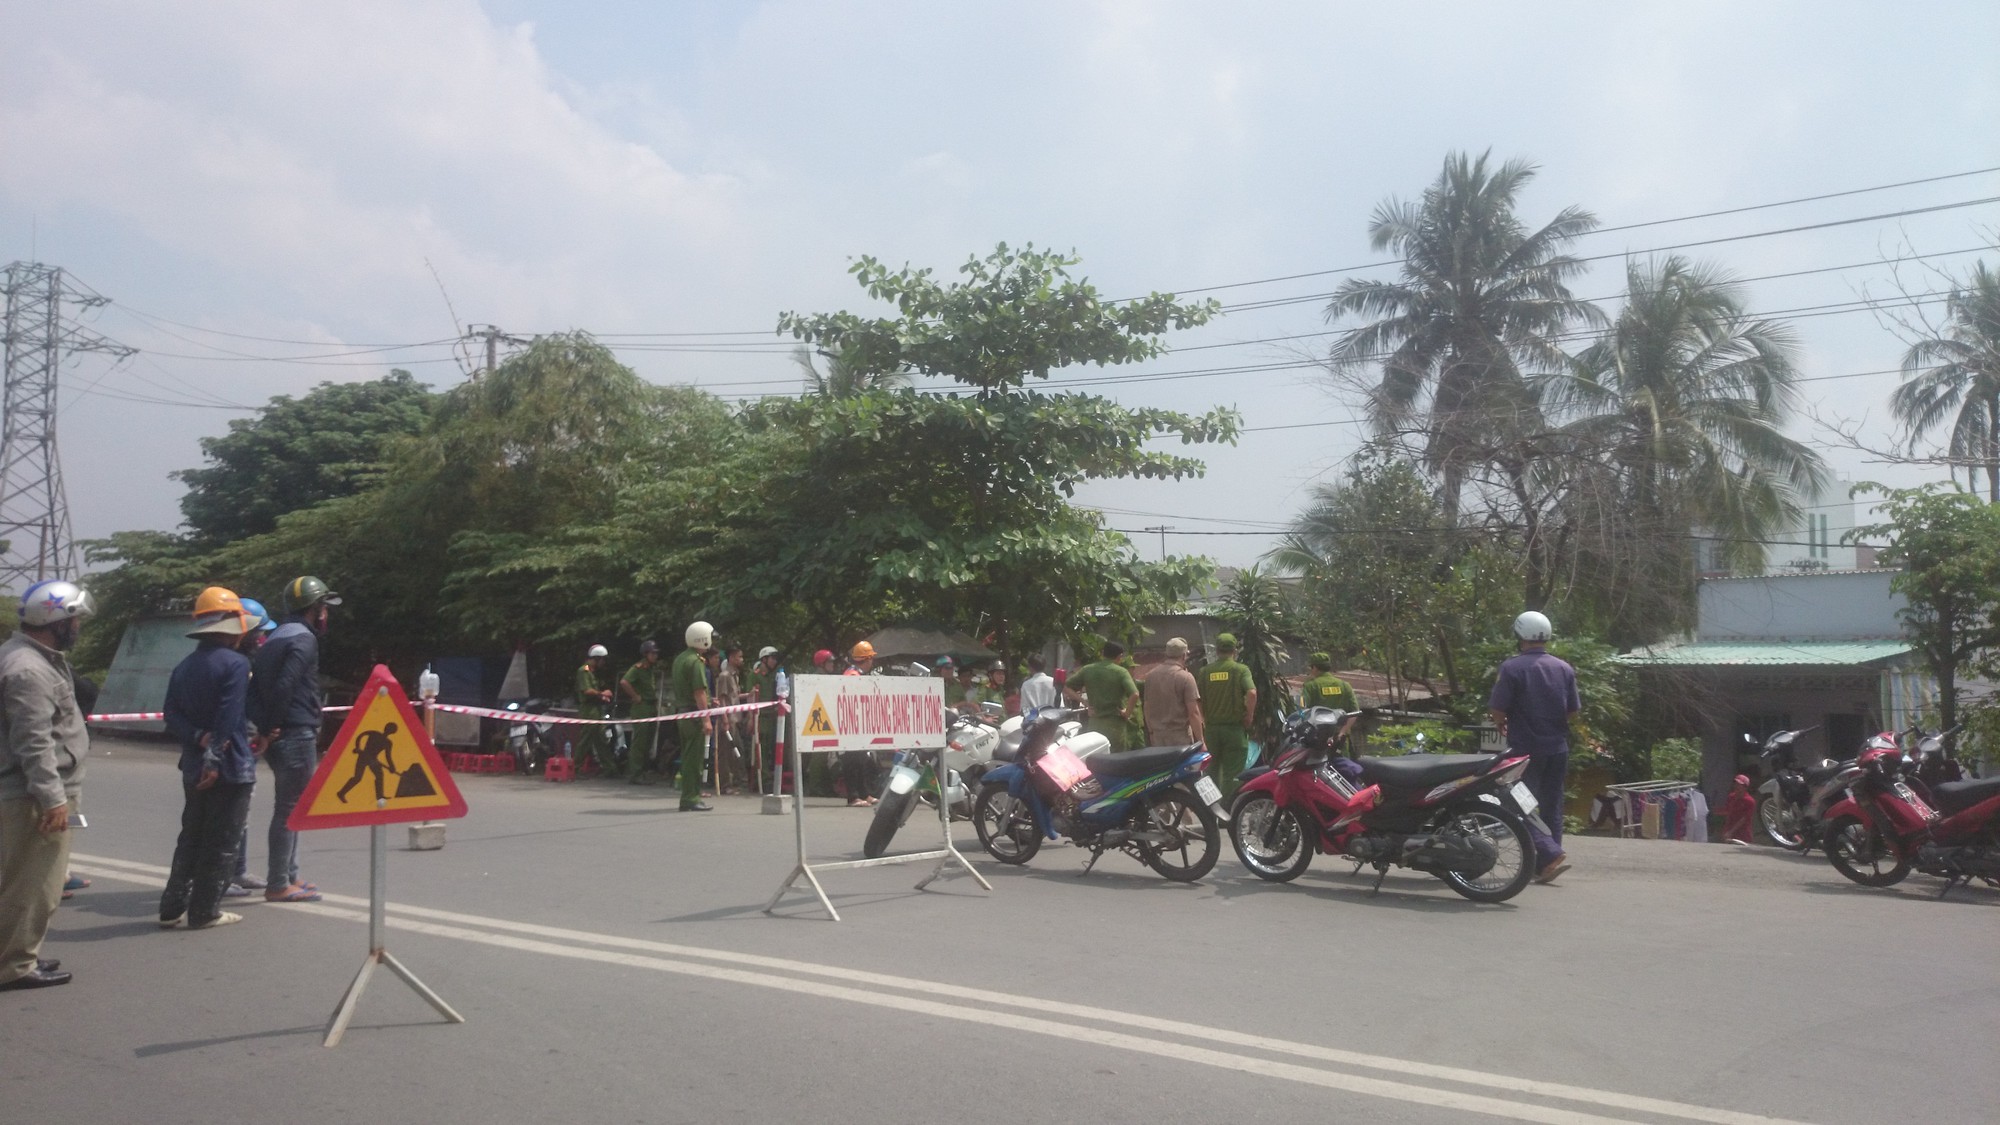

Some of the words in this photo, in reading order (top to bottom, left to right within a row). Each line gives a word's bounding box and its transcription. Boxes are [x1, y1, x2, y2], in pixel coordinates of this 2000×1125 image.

[836, 686, 859, 735] CÔNG
[860, 681, 891, 735] TRƯỜNG
[892, 694, 910, 734] ĐANG
[911, 694, 923, 734] THI
[924, 686, 942, 734] CÔNG
